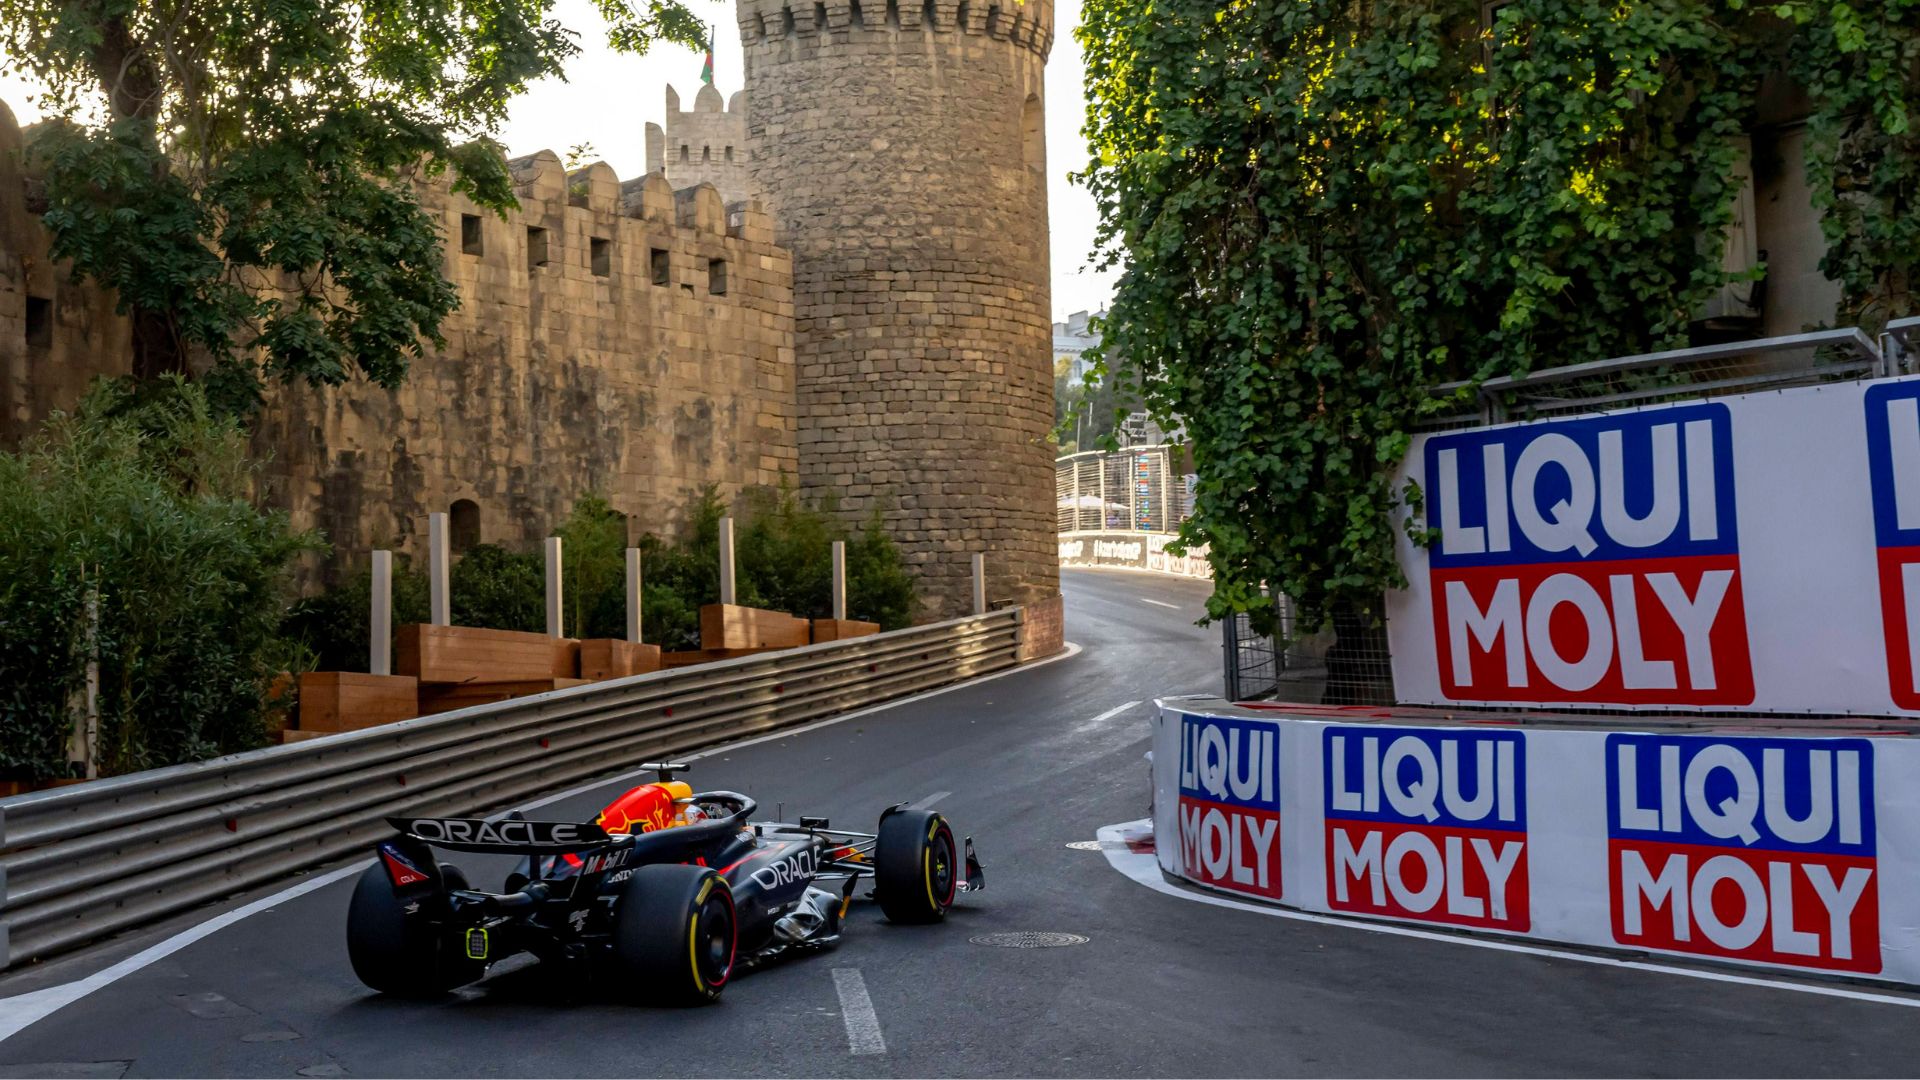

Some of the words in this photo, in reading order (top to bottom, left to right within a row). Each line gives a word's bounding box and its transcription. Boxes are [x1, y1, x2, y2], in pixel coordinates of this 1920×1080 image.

[1438, 419, 1718, 558] LIQUI
[1444, 569, 1735, 692] MOLY
[1183, 721, 1274, 802] LIQUI
[1331, 735, 1516, 823] LIQUI
[1617, 743, 1862, 846] LIQUI
[411, 819, 582, 844] ORACLE
[1180, 803, 1279, 889] MOLY
[1333, 828, 1525, 921] MOLY
[1621, 849, 1874, 960] MOLY
